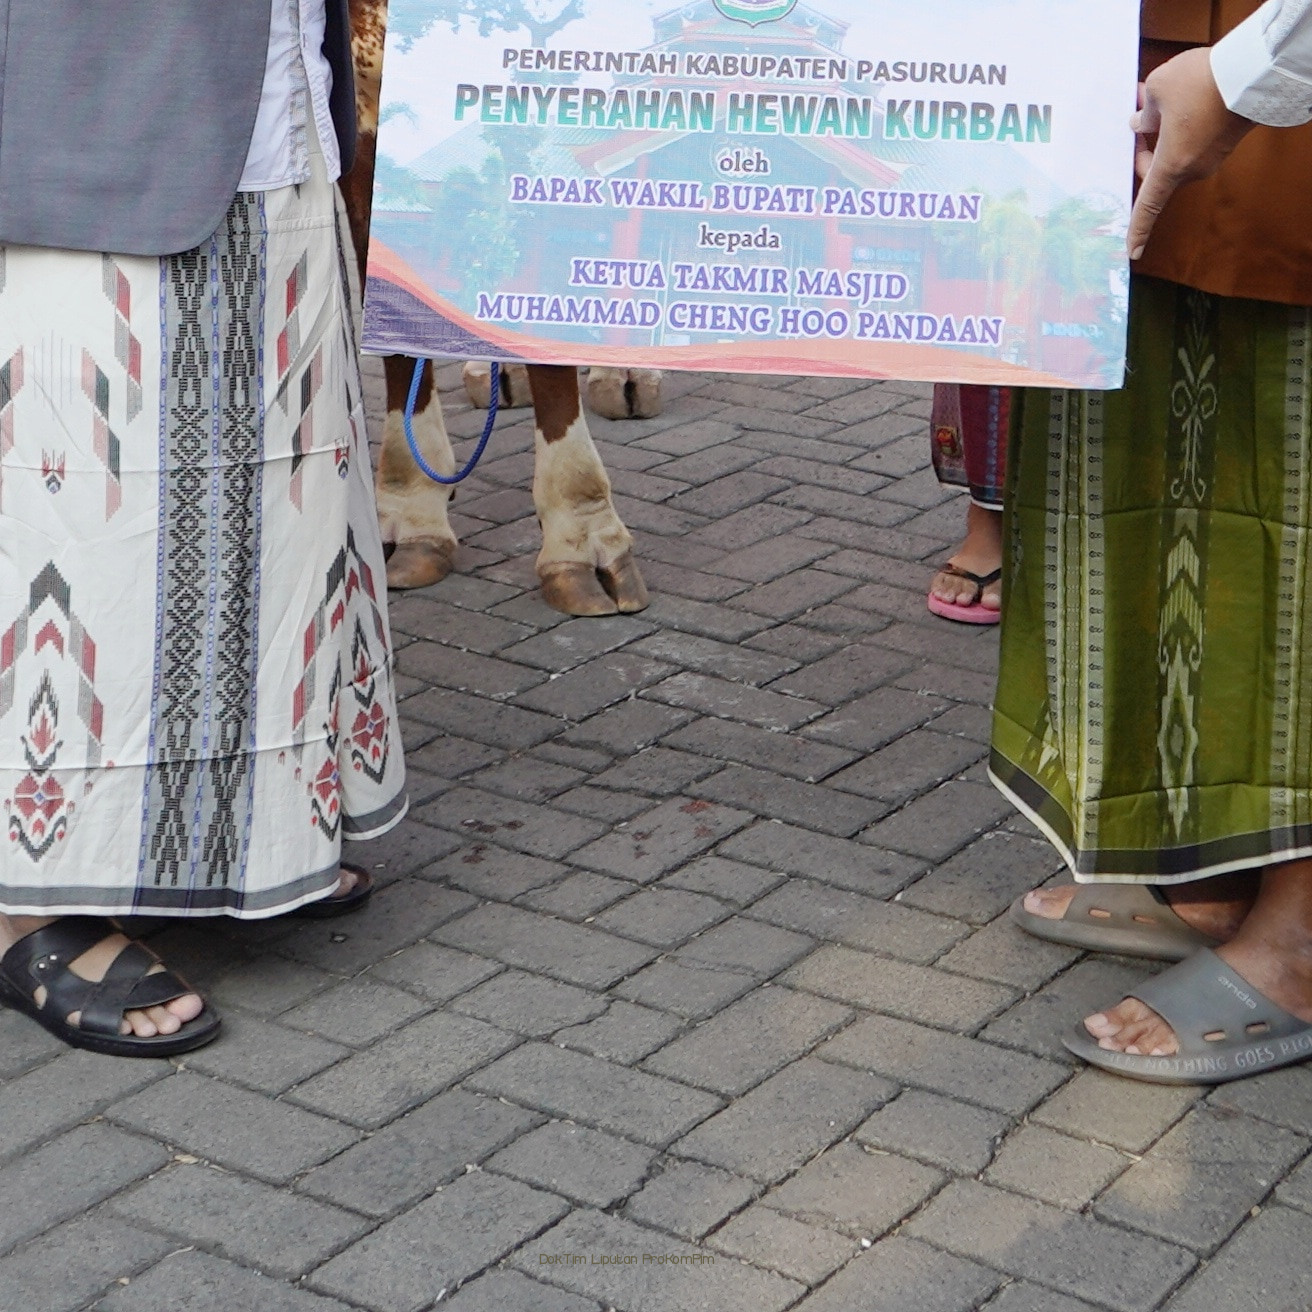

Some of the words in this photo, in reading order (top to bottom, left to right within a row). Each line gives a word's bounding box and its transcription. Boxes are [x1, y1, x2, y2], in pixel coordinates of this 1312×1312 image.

[502, 48, 677, 74] PEMERINTAH
[686, 54, 847, 80] KABUPATEN
[856, 59, 1007, 86] PASURUAN
[454, 83, 715, 130] PENYERAHAN
[727, 93, 872, 137] HEWAN
[886, 99, 1053, 143] KURBAN
[719, 151, 769, 173] oleh
[512, 176, 604, 203] BAPAK
[610, 181, 704, 208] WAKIL
[712, 185, 815, 213] BUPATI
[824, 189, 981, 220] PASURUAN
[699, 225, 780, 253] kepada
[571, 259, 666, 288] KETUA
[674, 264, 789, 294] TAKMIR
[797, 270, 907, 305] MASJID
[477, 293, 661, 327] MUHAMMAD
[669, 302, 770, 332] CHENG
[779, 308, 848, 336] HOO
[856, 312, 1003, 344] PANDAAN
[1235, 1046, 1275, 1068] GOES
